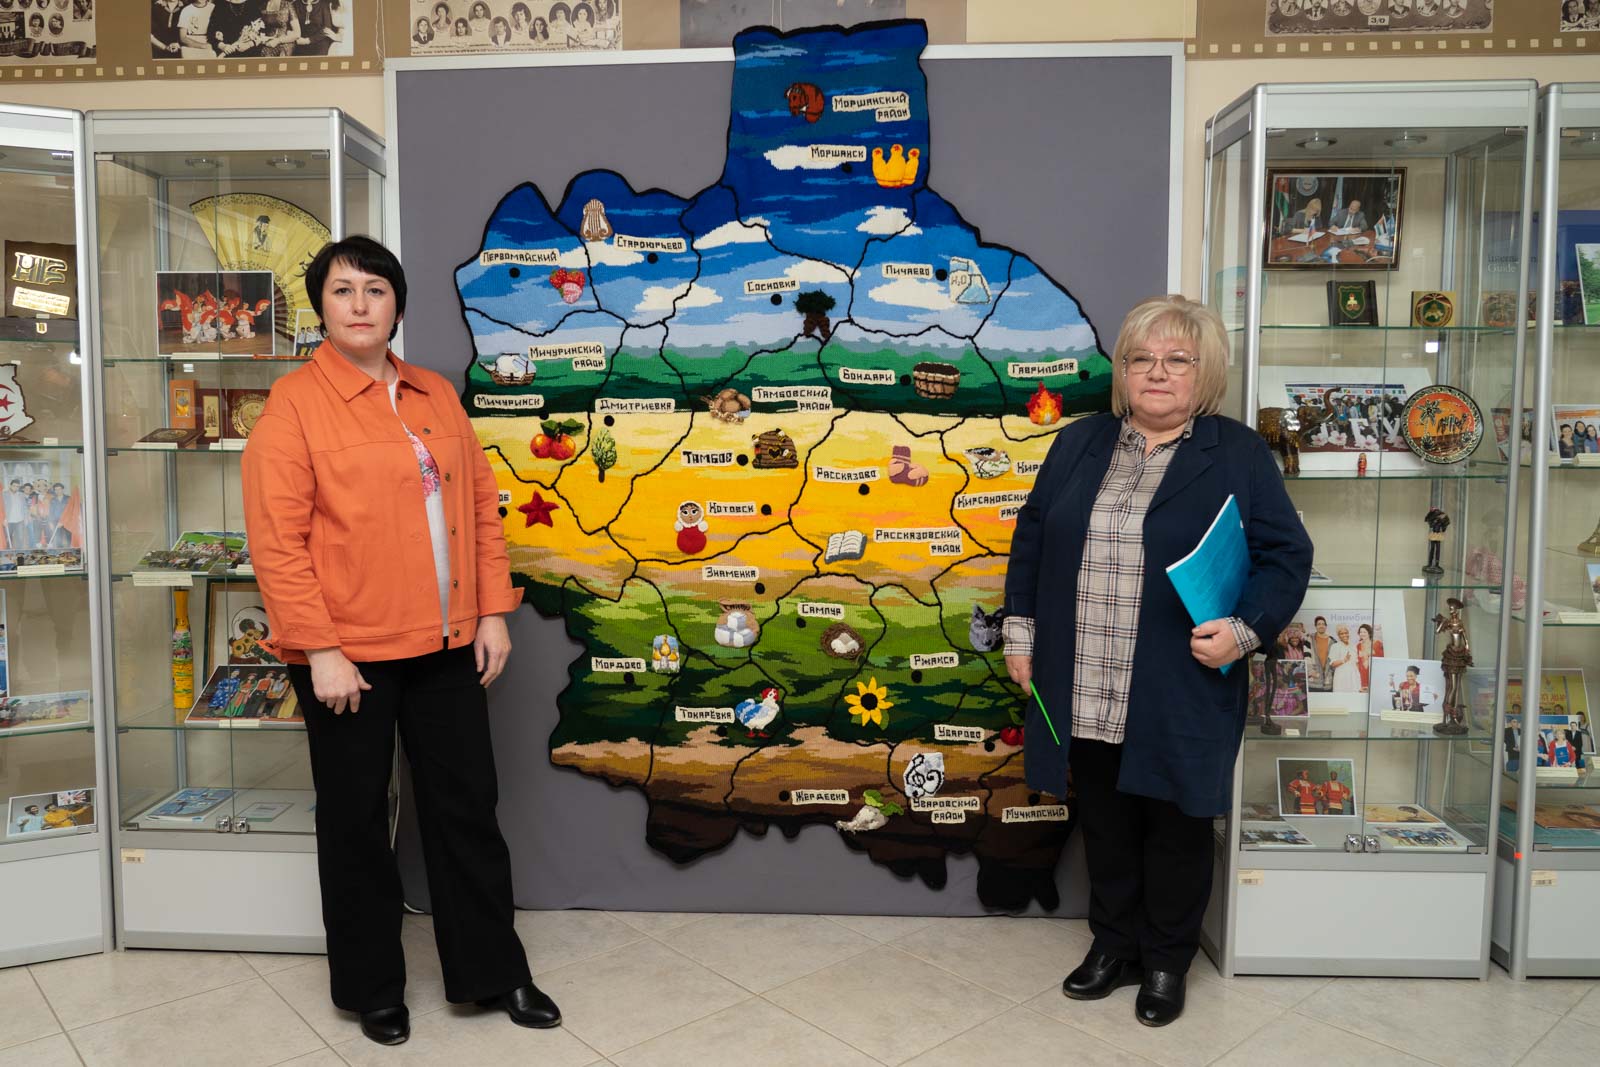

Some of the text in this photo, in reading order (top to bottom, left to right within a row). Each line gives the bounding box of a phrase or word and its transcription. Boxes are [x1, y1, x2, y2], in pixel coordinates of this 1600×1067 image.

[834, 96, 907, 109] Моршанский
[877, 108, 908, 121] район
[811, 147, 864, 159] Моршанск
[617, 236, 683, 250] Староюрьево
[483, 250, 558, 264] Первомайский
[885, 264, 931, 277] Пичаево
[747, 279, 797, 293] Сосновка
[530, 345, 601, 358] Мичуринский
[574, 358, 604, 368] район
[1012, 361, 1075, 374] Гавриловка
[844, 369, 892, 382] Бондари
[755, 387, 827, 400] Тамбовский
[476, 395, 540, 407] Мичуринск
[601, 400, 671, 411] Дмитриевка
[799, 400, 832, 412] район
[683, 450, 733, 465] Тамбов
[816, 467, 877, 480] Рассказово
[957, 493, 1028, 508] Кирсановски
[708, 501, 754, 514] Котовск
[1001, 507, 1020, 518] рай
[875, 528, 961, 541] Рассказовский
[931, 541, 962, 553] район
[705, 566, 757, 579] Знаменка
[801, 603, 842, 617] Сампур
[595, 659, 642, 671] Мордово
[914, 654, 957, 666] Ржакса
[679, 708, 732, 721] Токарёвка
[938, 727, 981, 739] Уварово
[795, 788, 848, 803] Жердевка
[913, 798, 979, 809] Уваровский
[934, 810, 964, 822] район
[1005, 806, 1066, 820] Мучкапский
